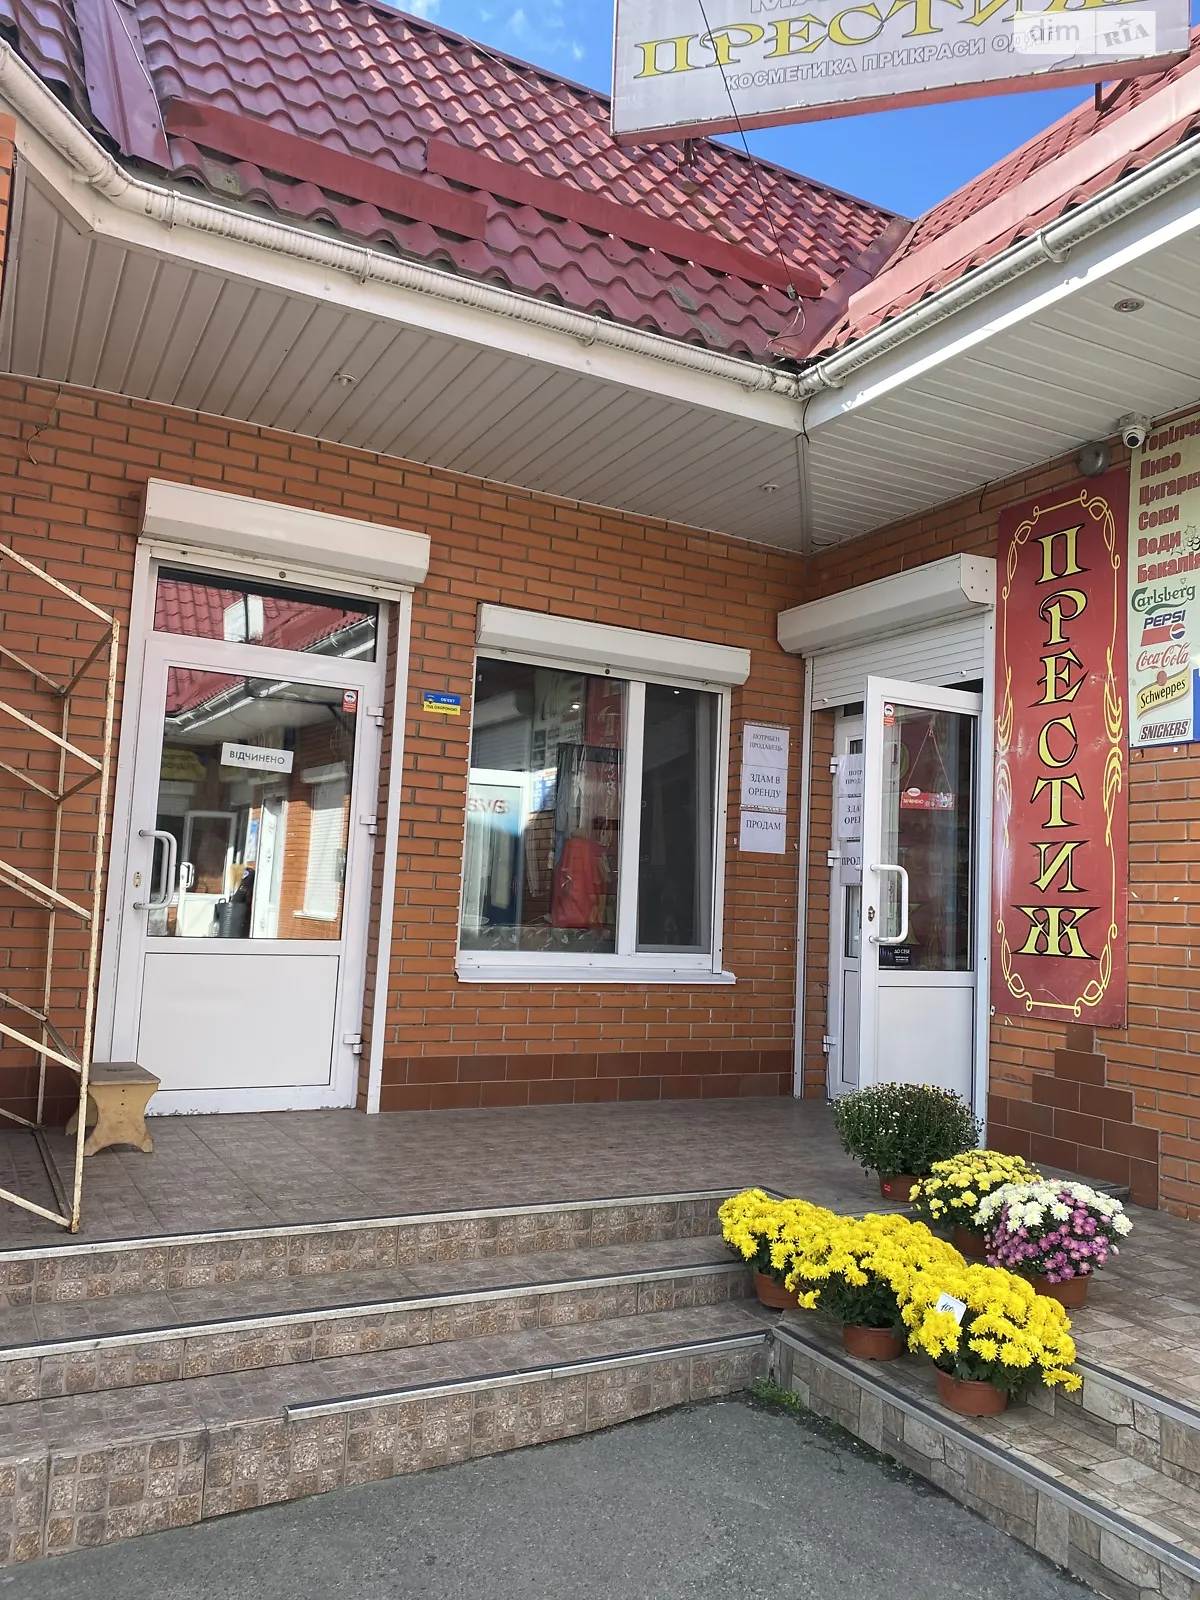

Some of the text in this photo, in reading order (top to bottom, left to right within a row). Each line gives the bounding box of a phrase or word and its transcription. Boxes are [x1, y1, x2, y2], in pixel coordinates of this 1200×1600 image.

[633, 0, 1150, 79] ПРЕСТИ
[724, 58, 857, 91] КОСМЕТИКА
[862, 37, 986, 71] ПРИКРАСИ
[1140, 452, 1182, 480] Пиво
[1138, 504, 1180, 531] Соки
[1137, 530, 1182, 558] Води
[1131, 585, 1196, 613] Carlsberg
[1143, 609, 1187, 630] PEPSI
[1140, 677, 1187, 709] Schweppes
[1010, 522, 1101, 961] ПРЕСТИЖ
[1140, 720, 1189, 741] SNICKERS
[229, 750, 285, 765] ВІДЧИНЕНО
[750, 773, 781, 785] ЗДАМ В
[748, 787, 781, 799] ОРЕНДУ
[746, 819, 781, 831] ПРОДАМ
